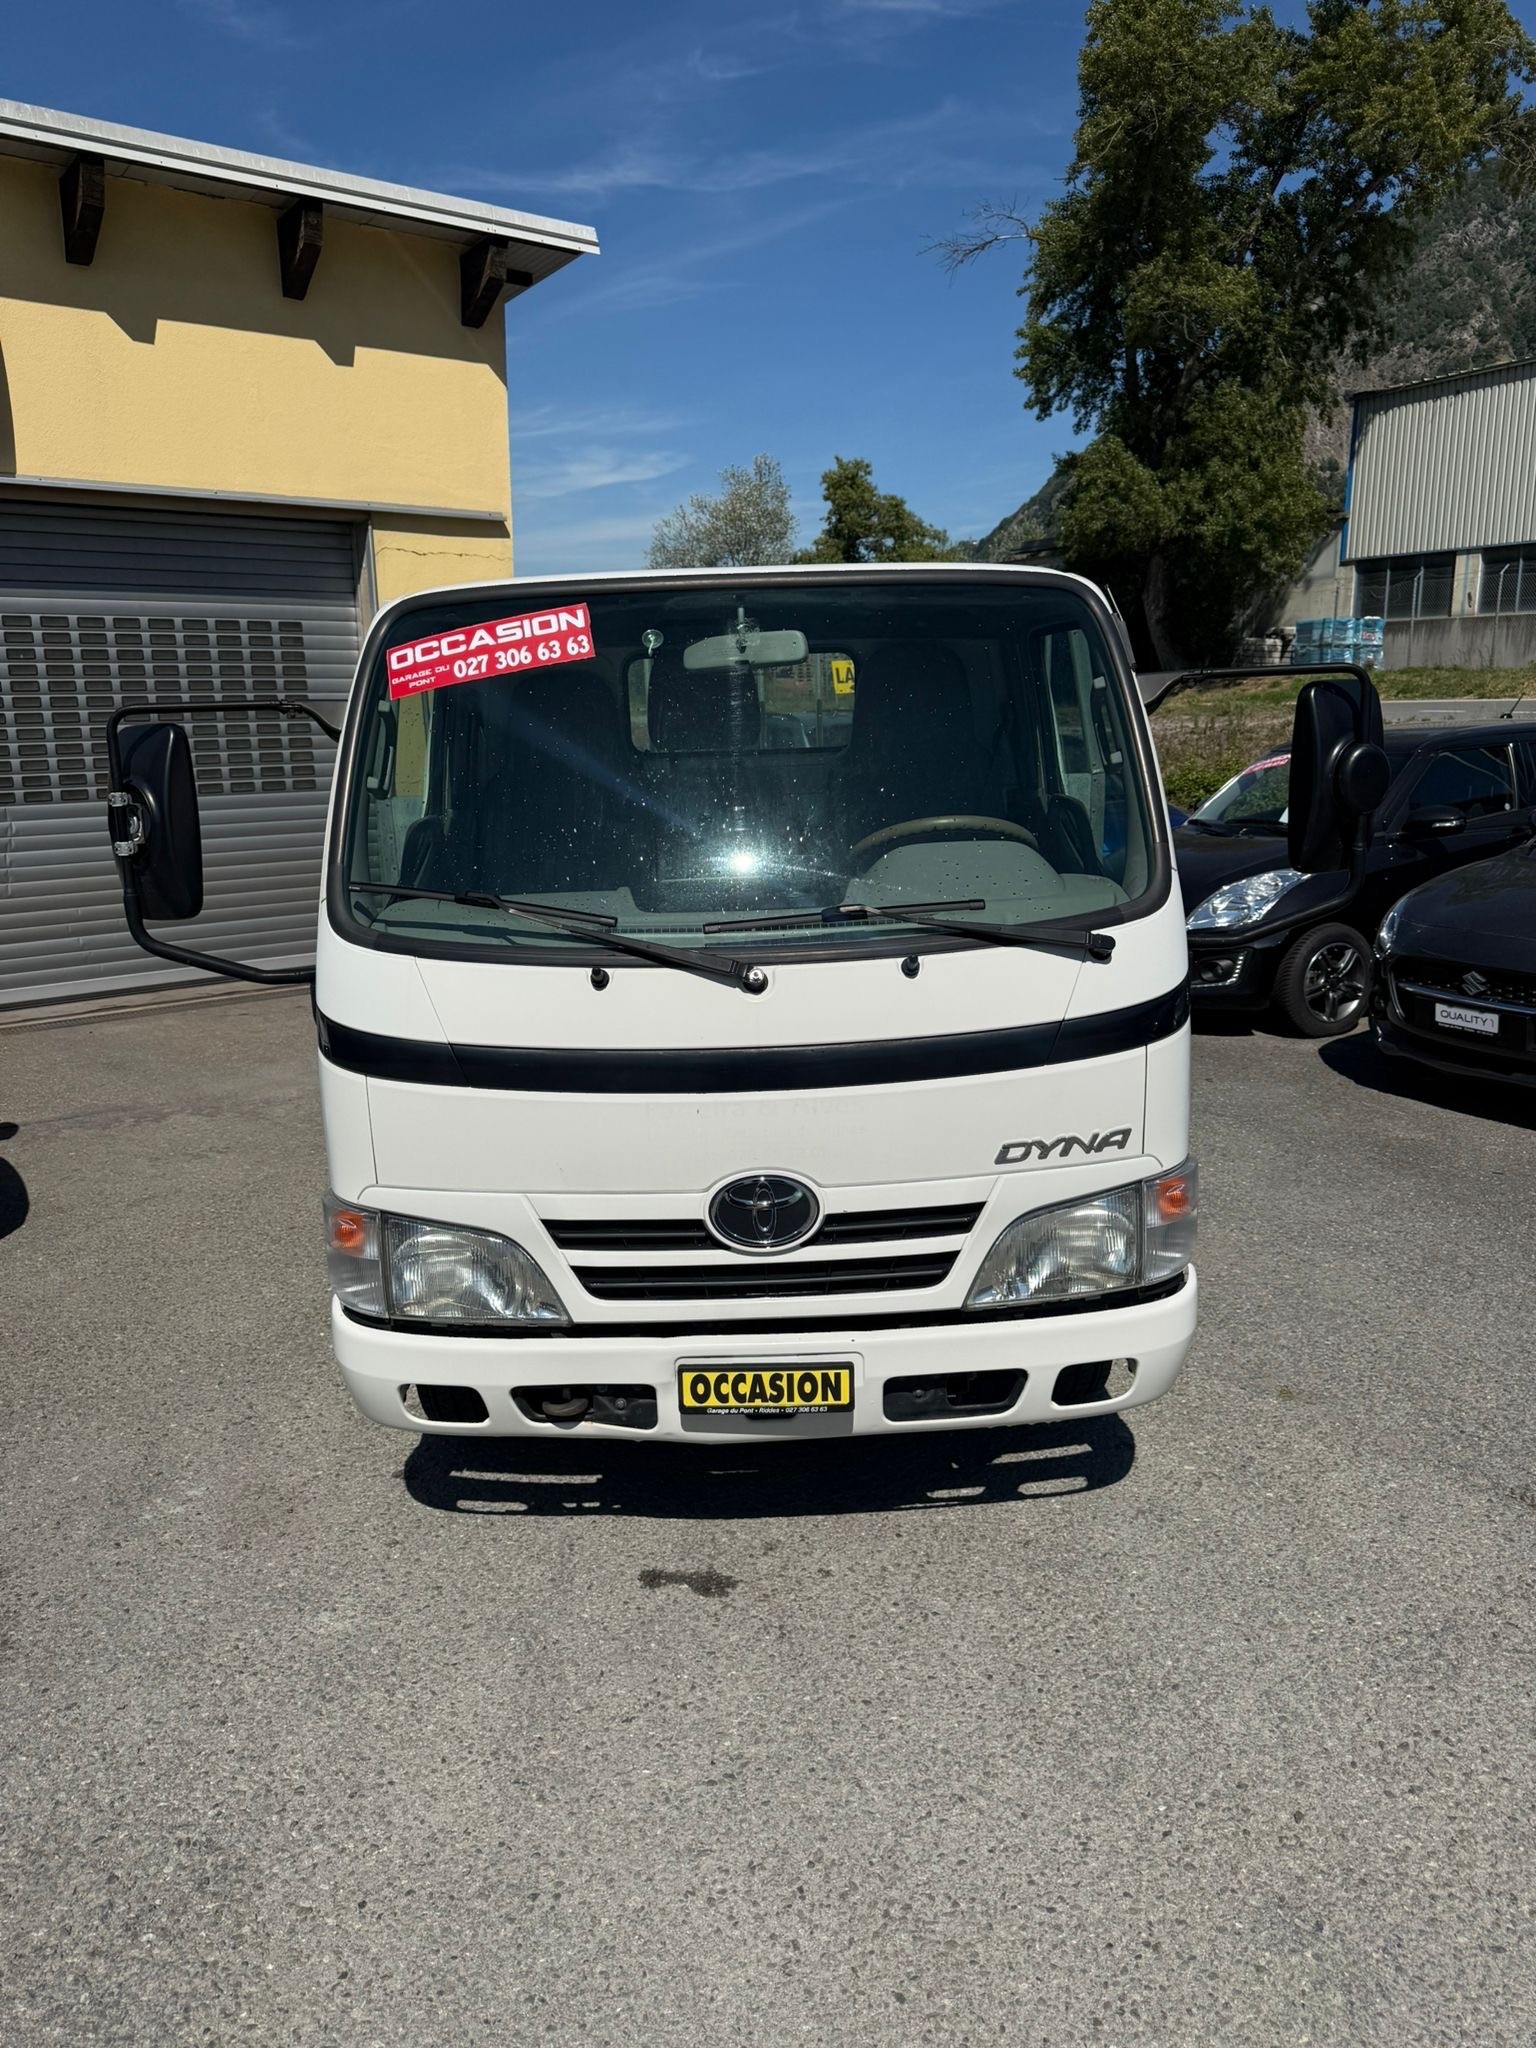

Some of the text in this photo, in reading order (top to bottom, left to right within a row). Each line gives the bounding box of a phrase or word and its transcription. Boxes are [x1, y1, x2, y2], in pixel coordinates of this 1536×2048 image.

[390, 609, 586, 670] OCCASION
[453, 635, 590, 678] 027 306 63 63
[392, 664, 450, 685] GARAGE DU
[408, 676, 437, 689] PONT
[994, 1127, 1133, 1165] DYNA
[690, 1372, 842, 1404] OCCASION
[707, 1407, 730, 1415] Garage
